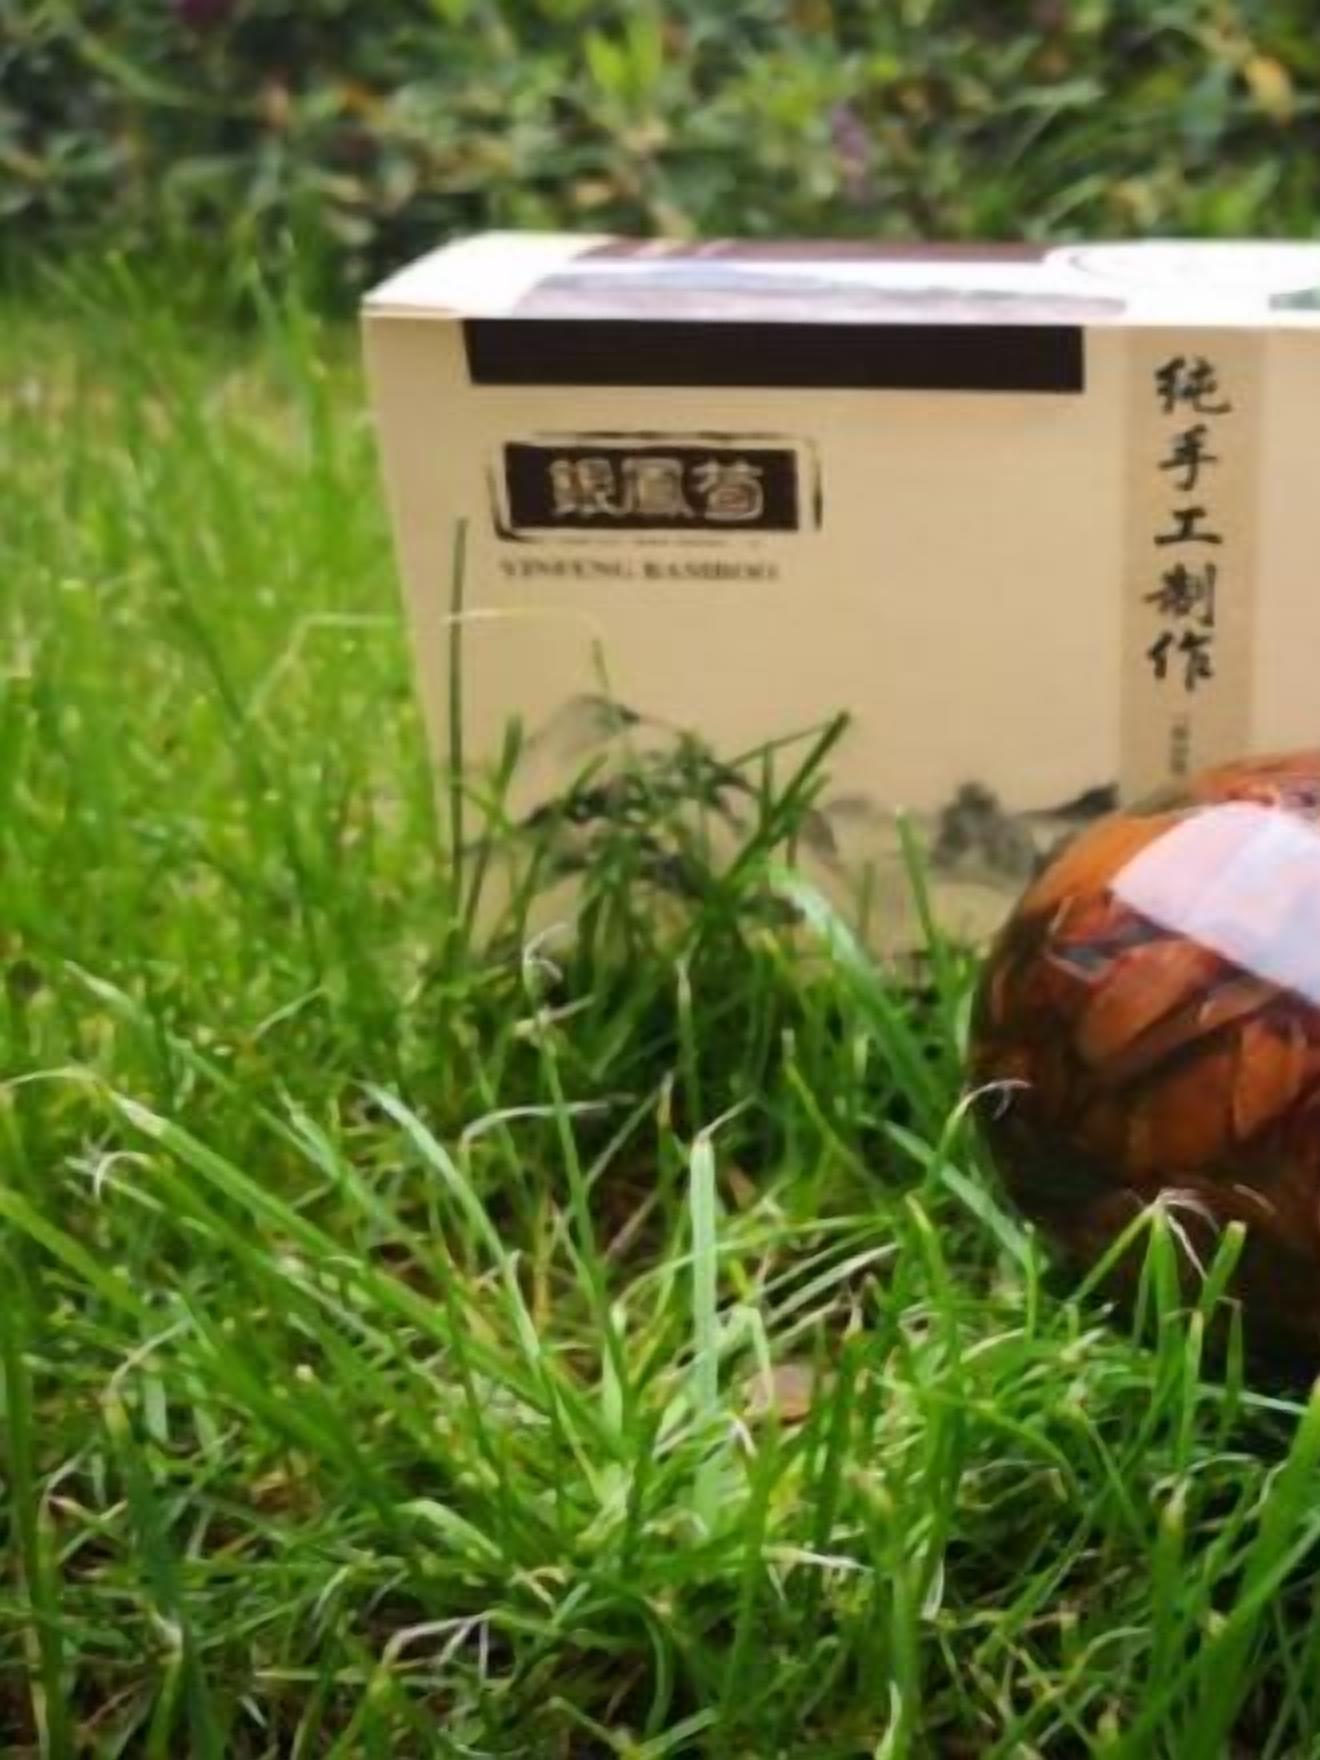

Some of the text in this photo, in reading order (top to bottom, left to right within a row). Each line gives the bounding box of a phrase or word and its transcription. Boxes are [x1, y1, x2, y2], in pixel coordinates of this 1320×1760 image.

[1141, 353, 1233, 692] 纯手工制作
